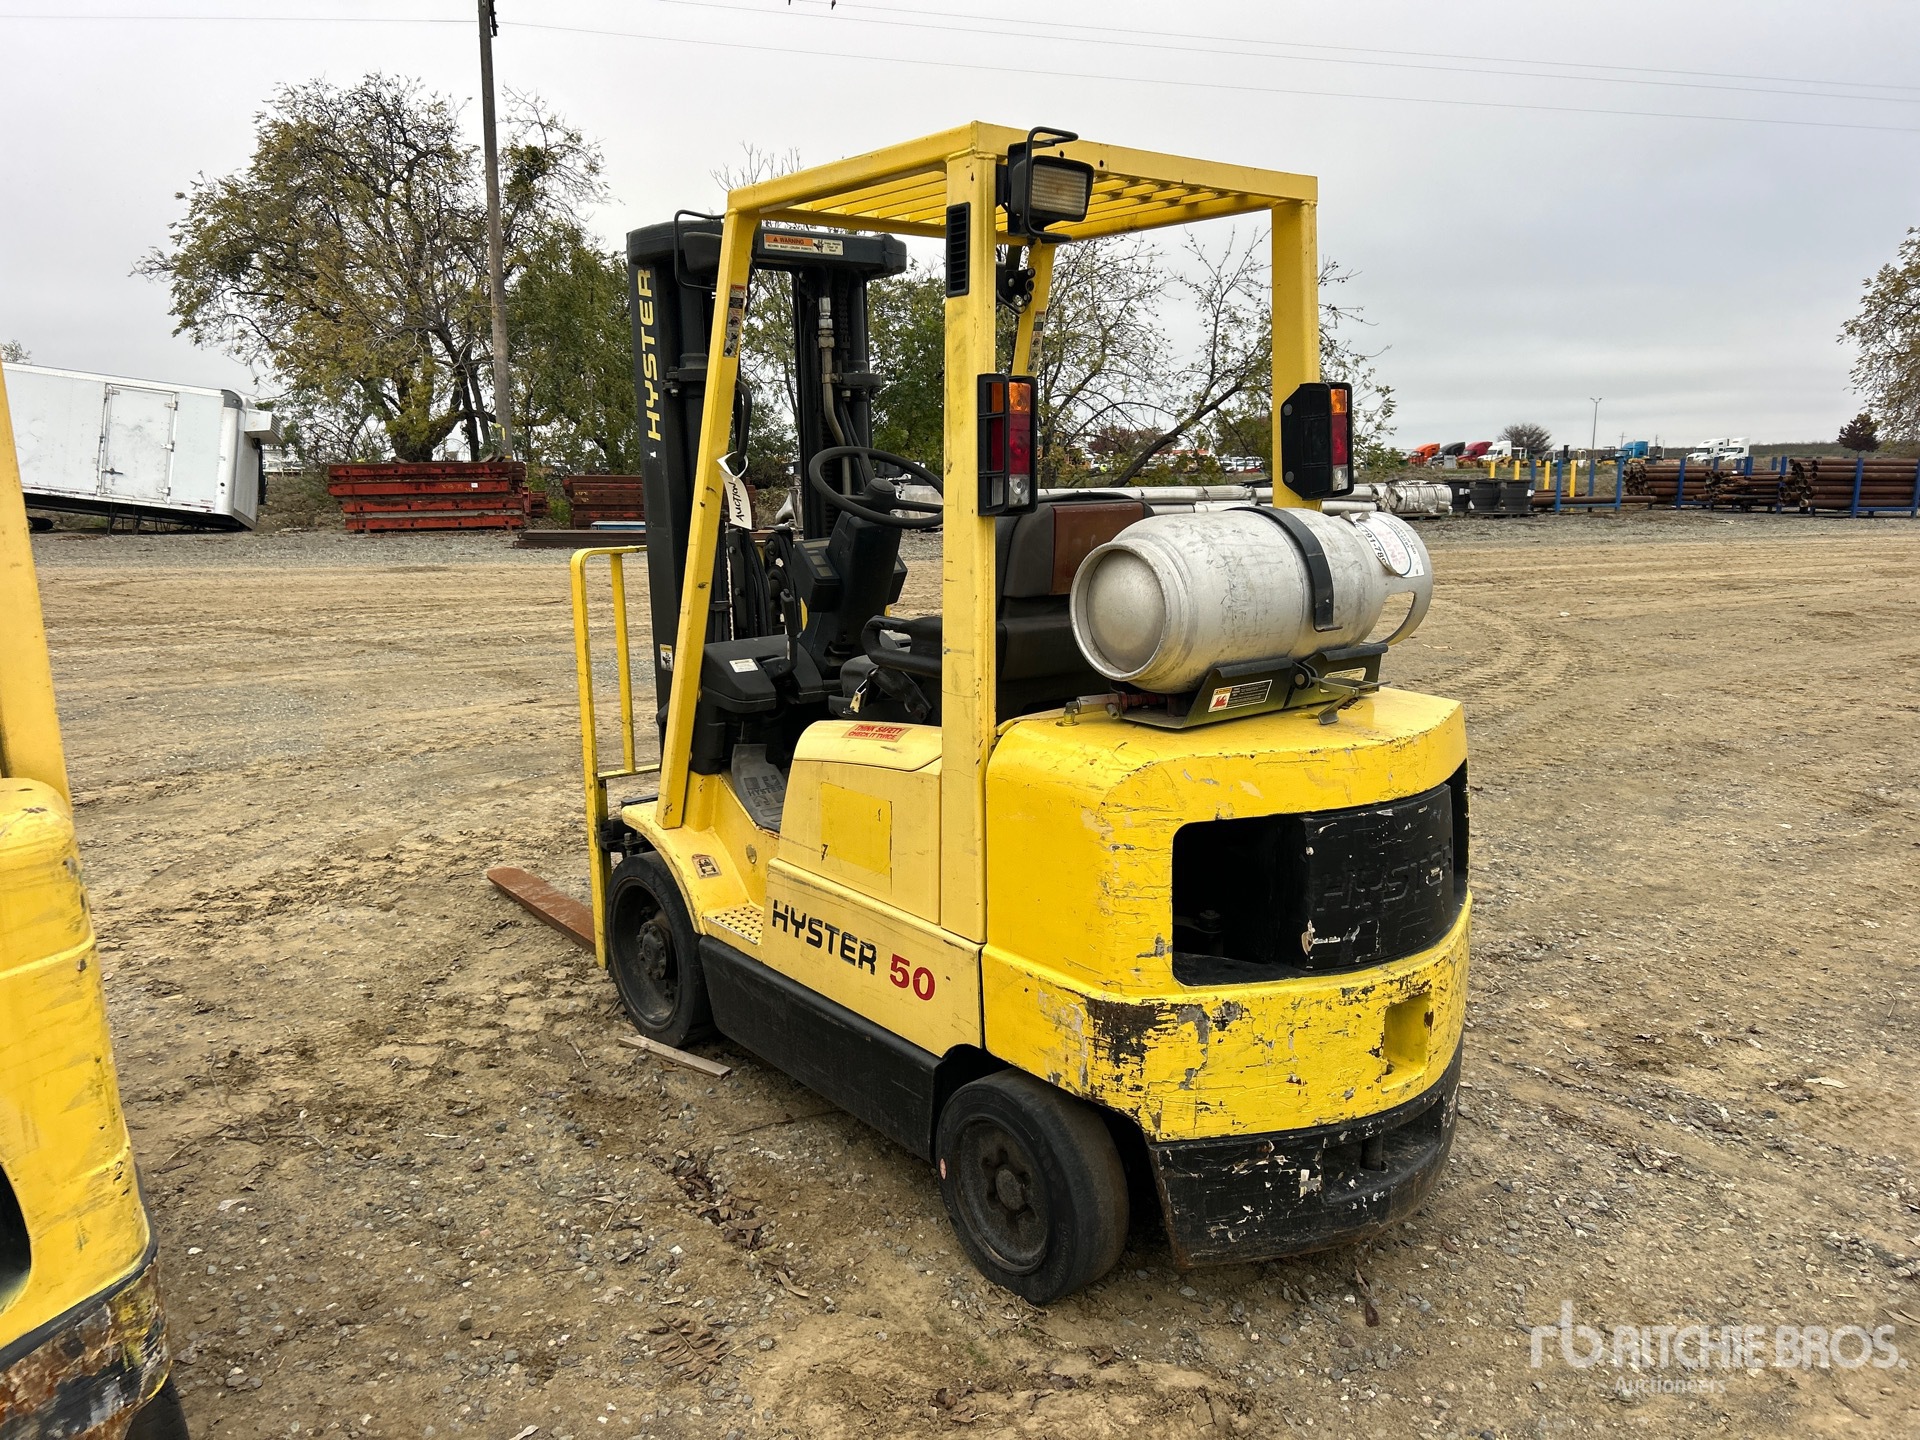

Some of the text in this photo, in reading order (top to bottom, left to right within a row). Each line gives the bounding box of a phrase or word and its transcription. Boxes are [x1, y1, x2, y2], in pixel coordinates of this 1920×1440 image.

[637, 269, 662, 442] HYSTER
[875, 726, 905, 734] SAFETY
[771, 899, 936, 1001] HYSTER 50
